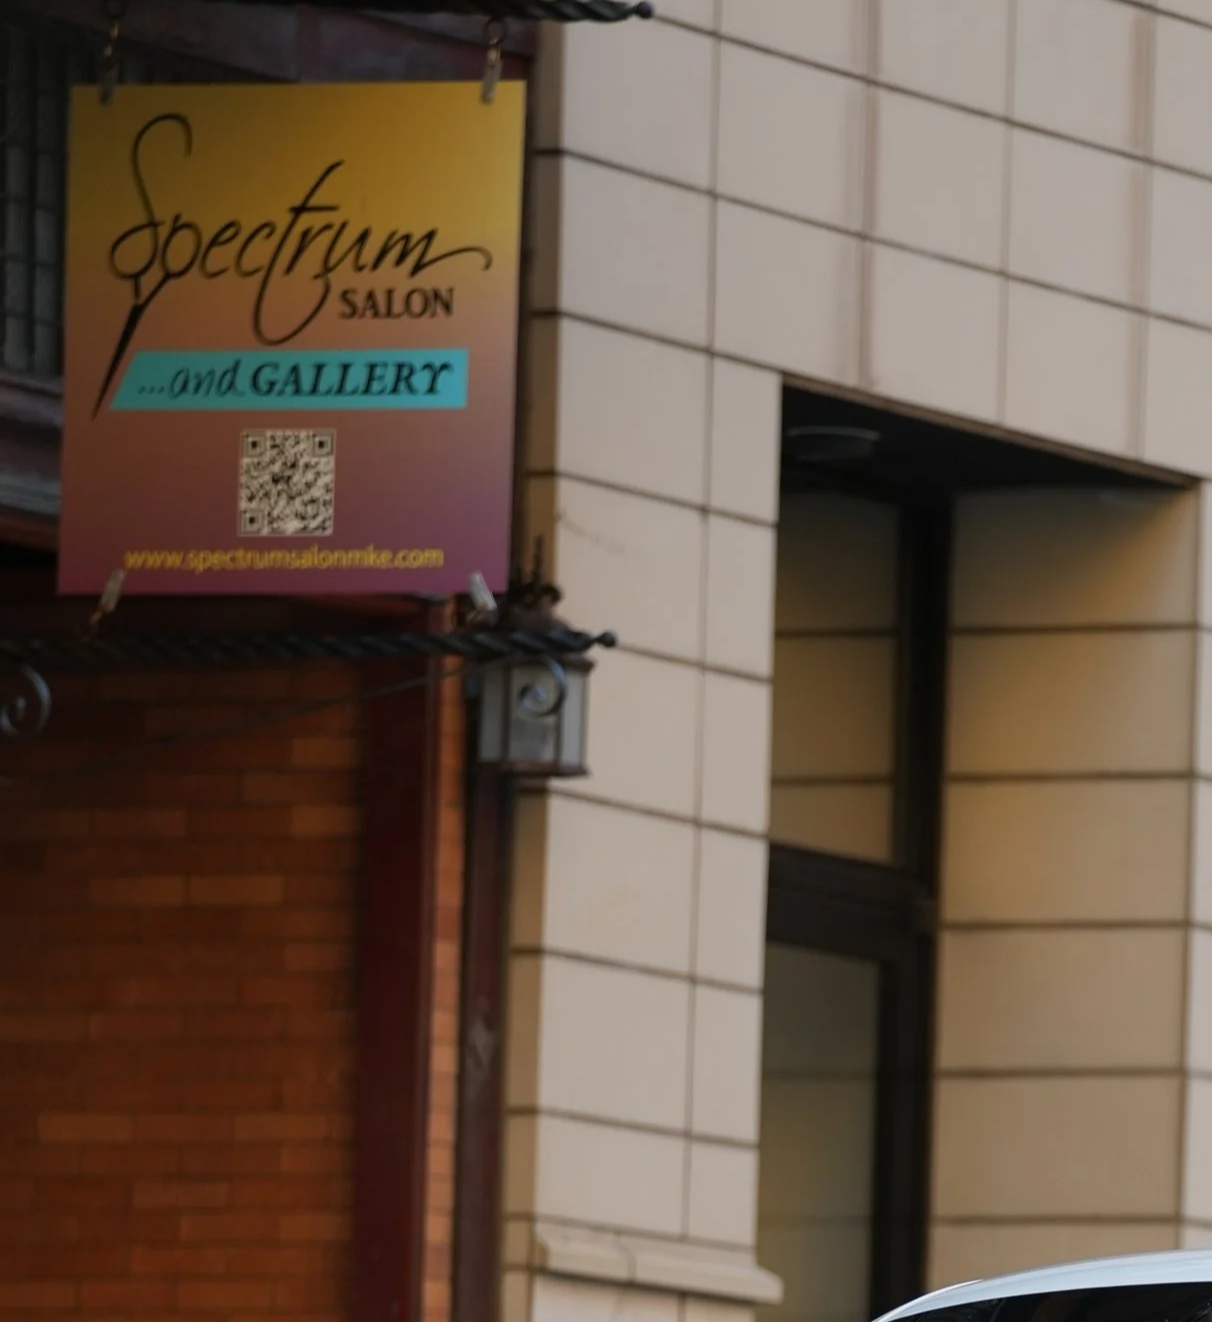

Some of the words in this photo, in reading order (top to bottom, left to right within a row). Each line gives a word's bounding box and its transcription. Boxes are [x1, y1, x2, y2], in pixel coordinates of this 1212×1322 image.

[104, 112, 494, 346] Spectrum
[338, 286, 456, 320] SALON
[251, 360, 456, 398] GALLERY
[124, 543, 445, 572] www.spectrumsalonmke.com
